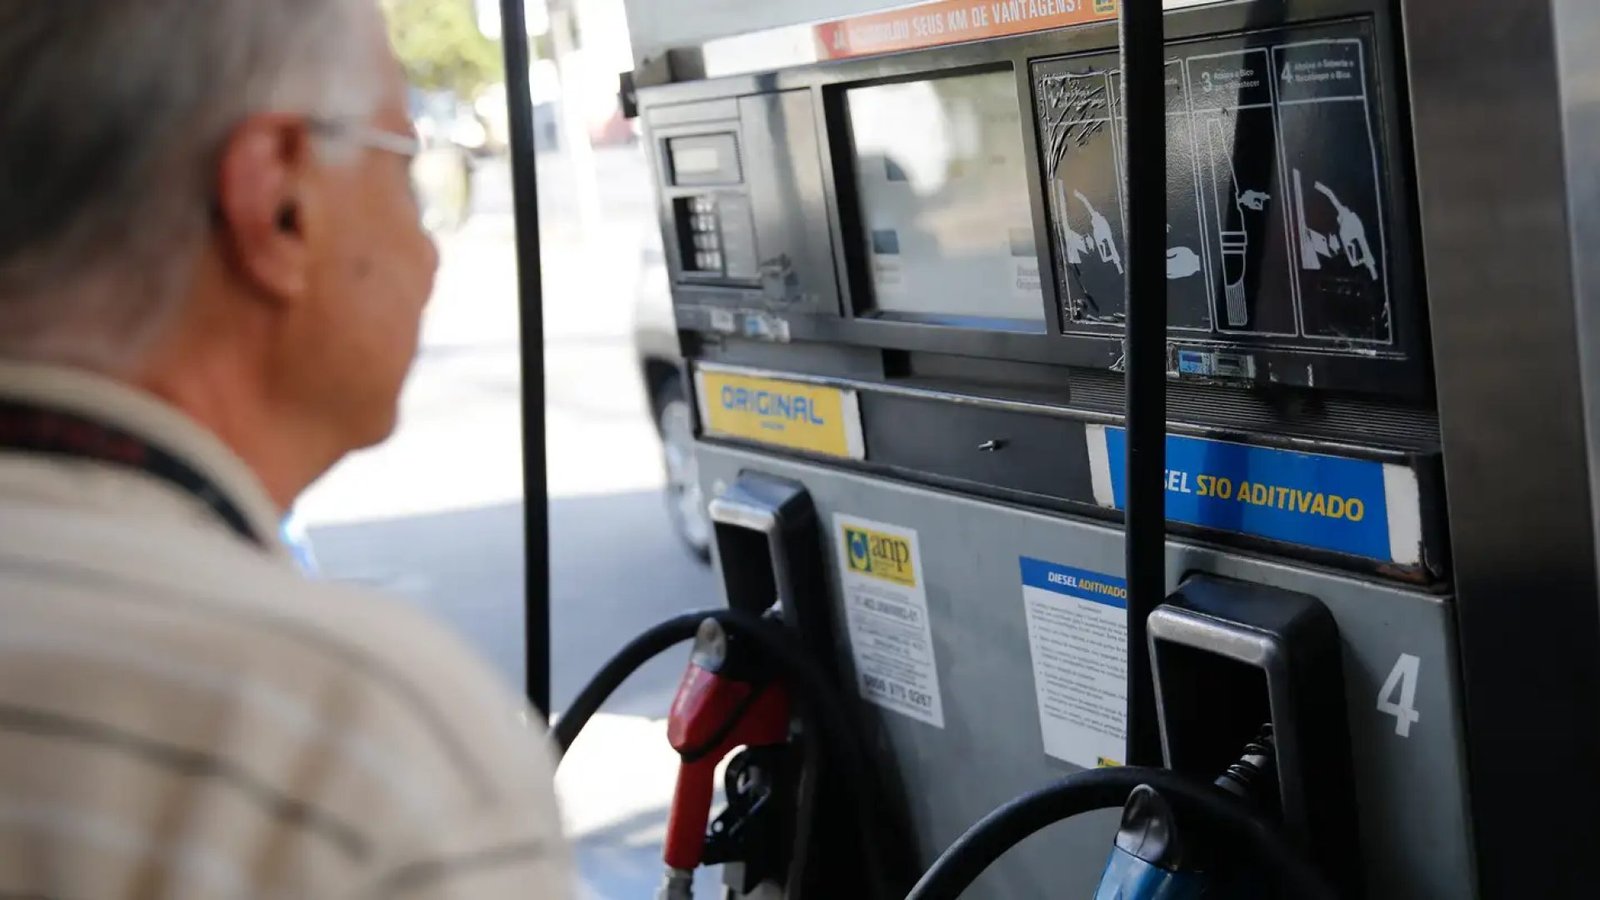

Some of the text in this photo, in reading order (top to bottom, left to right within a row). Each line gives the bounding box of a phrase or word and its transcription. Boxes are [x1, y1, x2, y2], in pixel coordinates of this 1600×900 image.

[912, 13, 944, 37] SEUS
[947, 9, 968, 31] KM
[972, 6, 988, 28] DE
[1201, 72, 1212, 92] 3
[1281, 62, 1292, 84] 4
[720, 384, 824, 425] ORIGINAL
[1196, 475, 1232, 498] S10
[1236, 480, 1364, 522] ADITIVADO
[870, 534, 909, 572] anp
[1048, 571, 1127, 599] DIESEL ADITIVADO
[1377, 653, 1420, 738] 4
